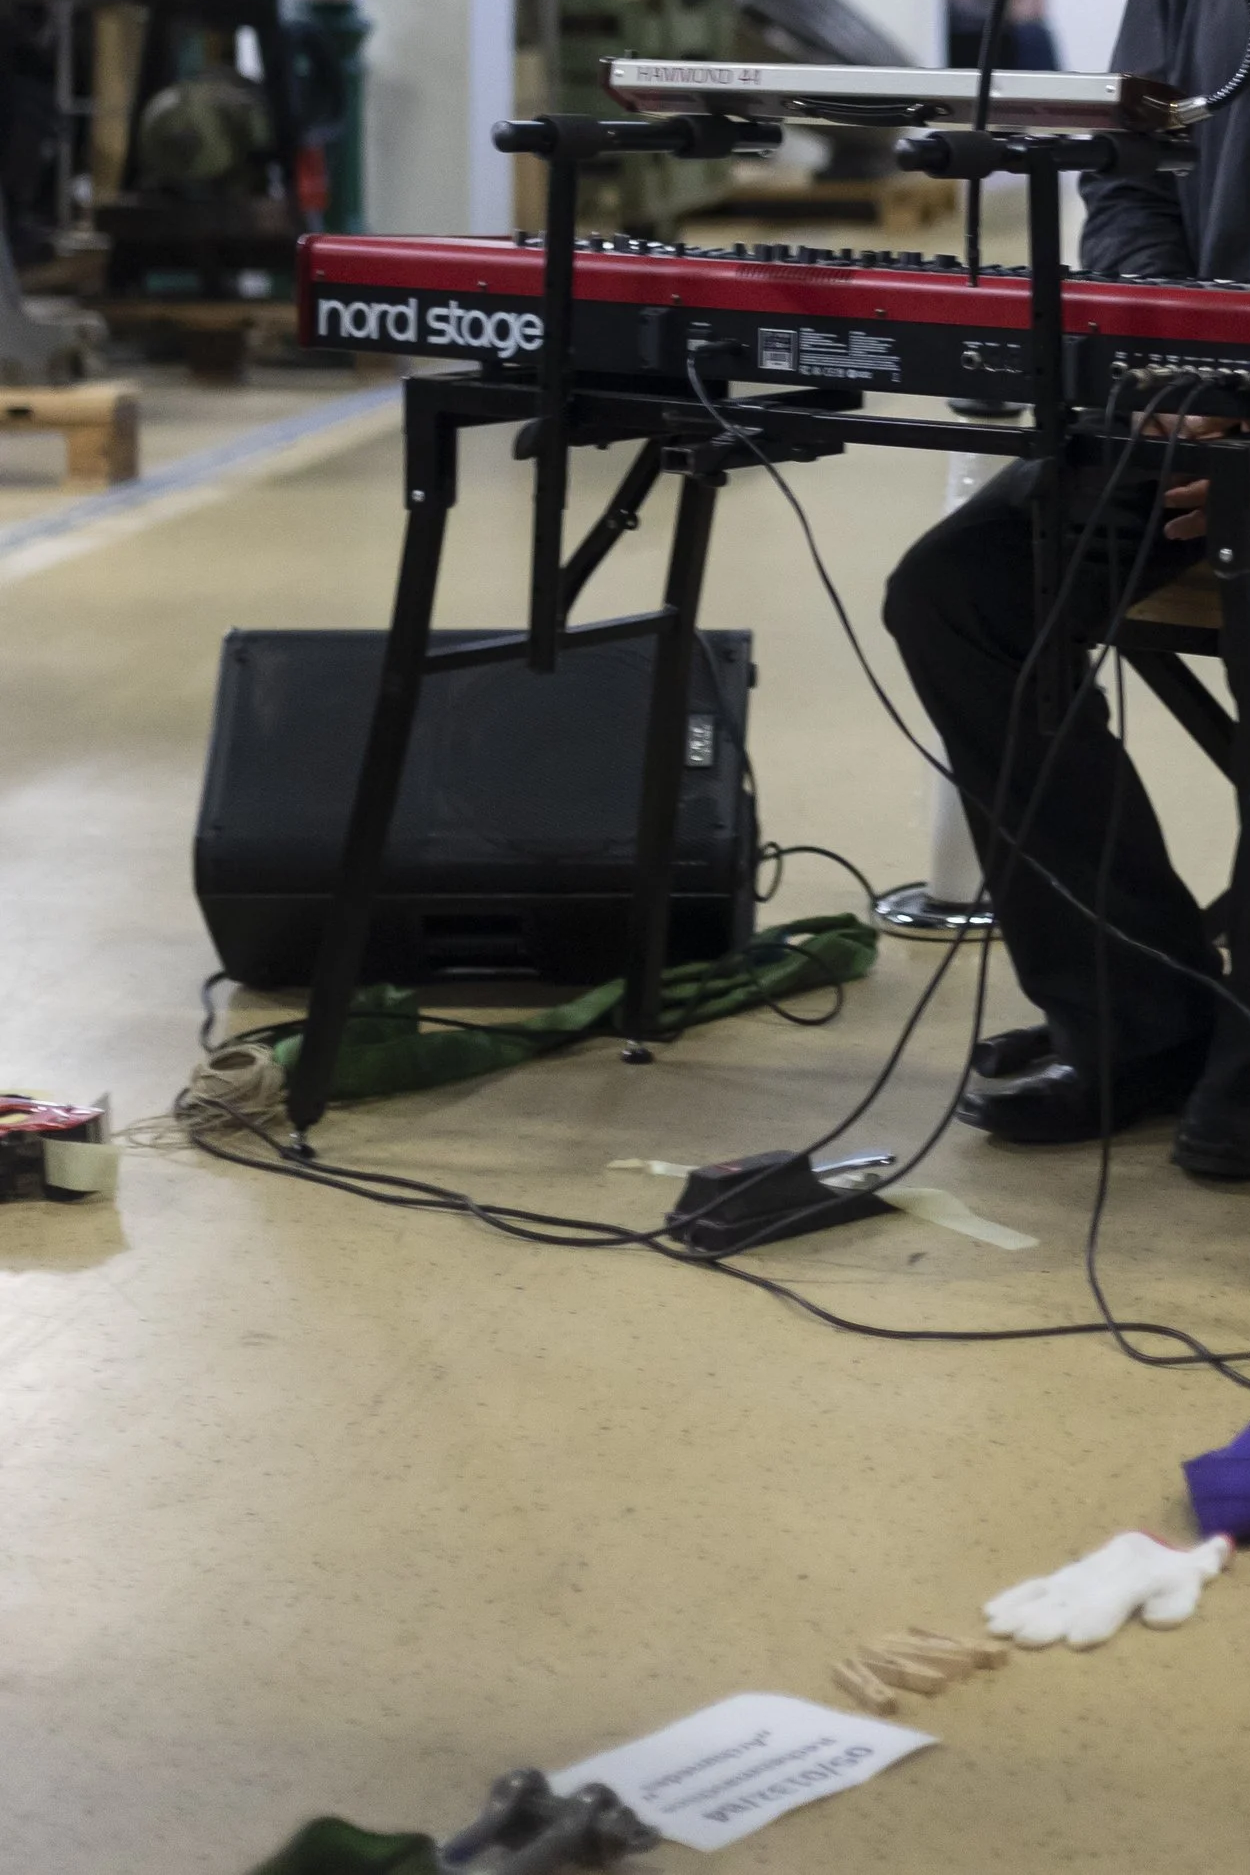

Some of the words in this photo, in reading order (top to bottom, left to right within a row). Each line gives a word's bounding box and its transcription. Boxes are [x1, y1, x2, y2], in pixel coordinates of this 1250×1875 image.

[636, 66, 731, 85] HAMMOND
[738, 69, 762, 85] 44
[317, 297, 418, 342] nord
[426, 299, 544, 359] stage
